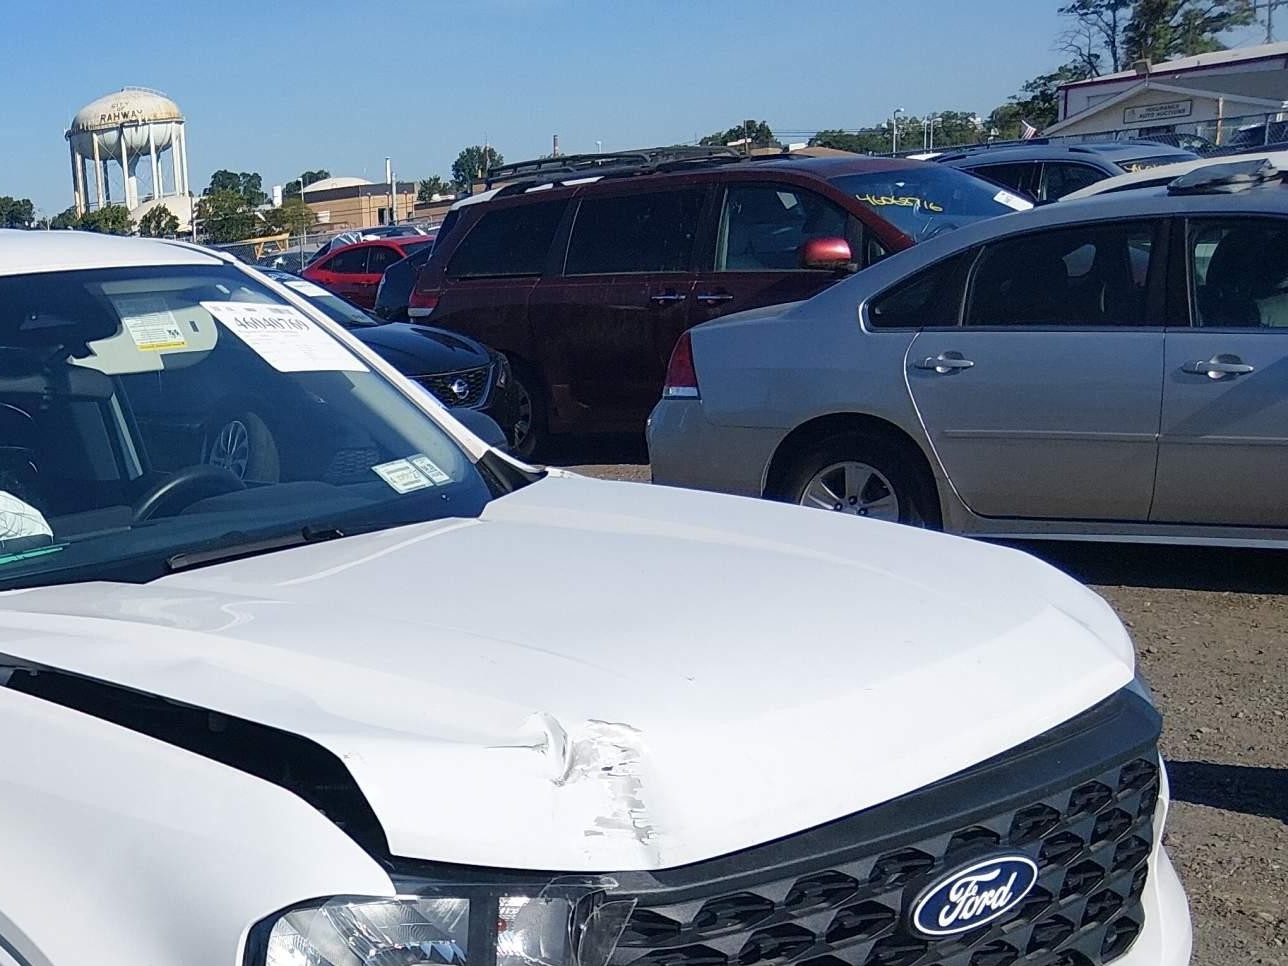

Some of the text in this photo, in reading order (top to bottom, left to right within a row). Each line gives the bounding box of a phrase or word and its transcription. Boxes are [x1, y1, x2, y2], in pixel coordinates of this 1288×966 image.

[100, 109, 143, 122] RAHWAY
[233, 316, 311, 331] 46040769
[938, 868, 1018, 927] Ford
